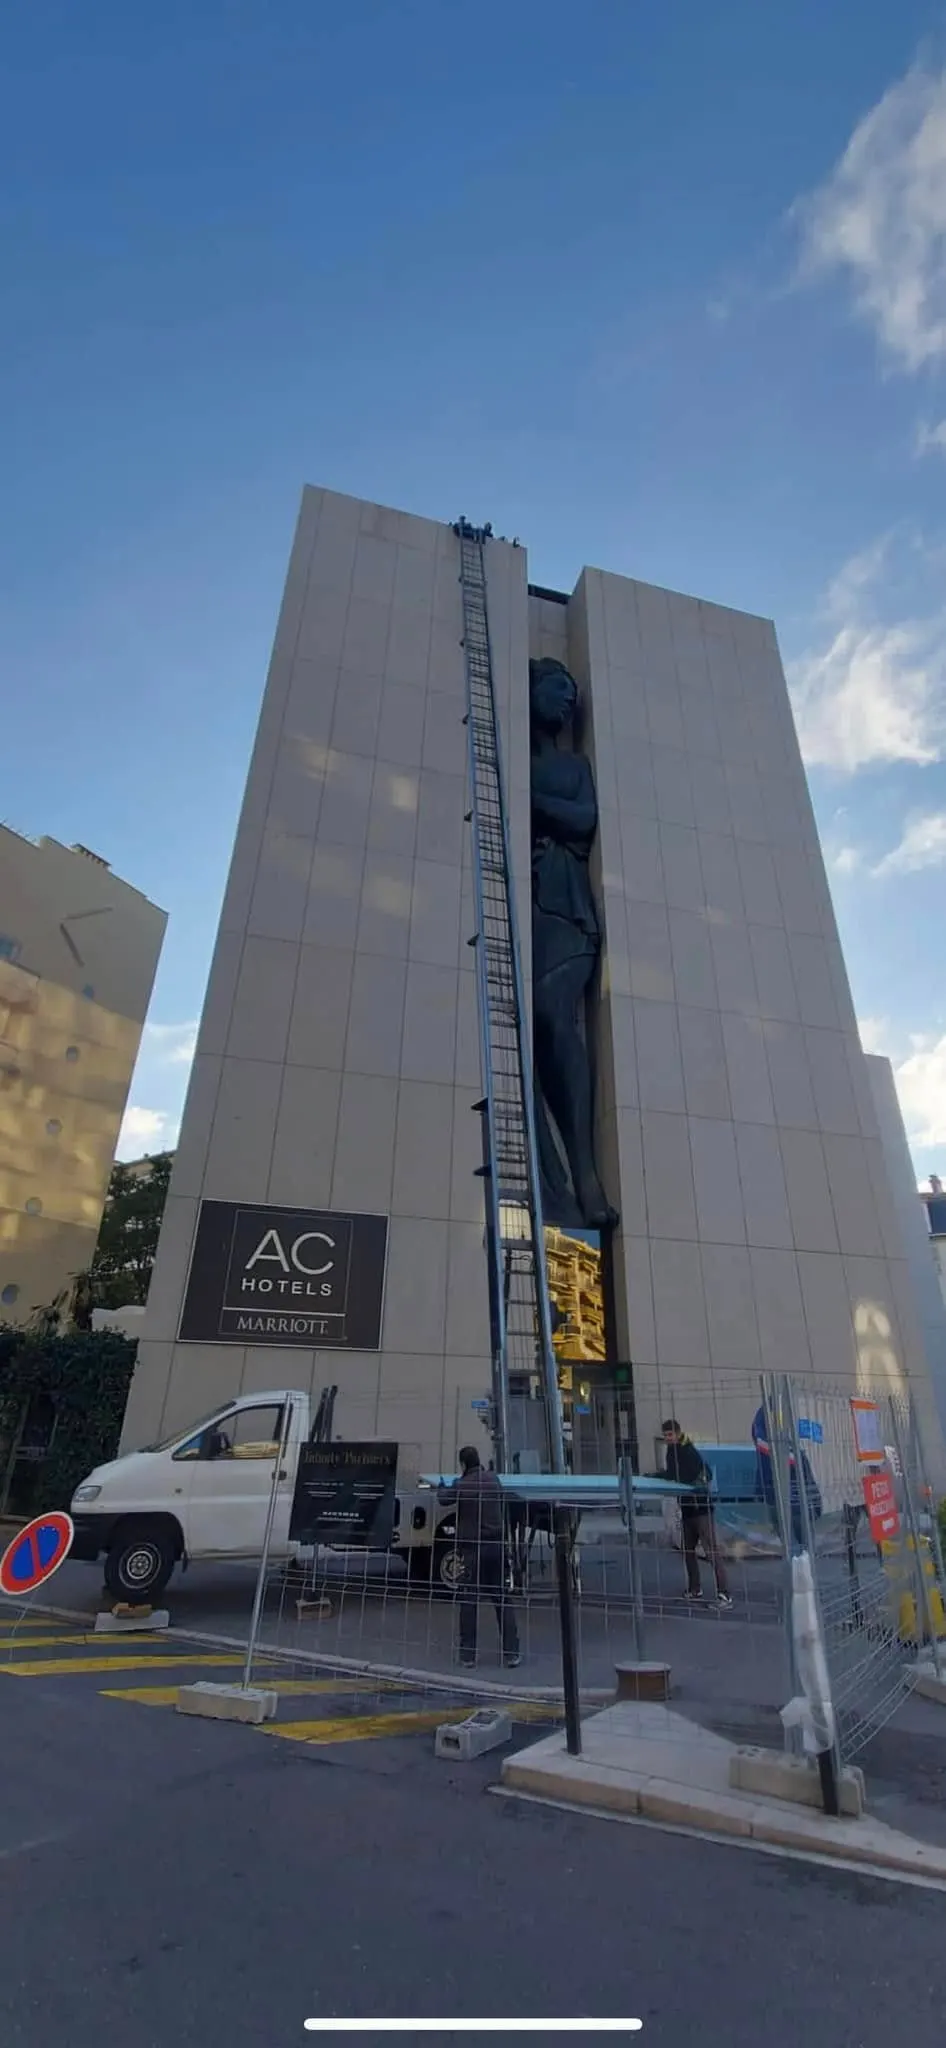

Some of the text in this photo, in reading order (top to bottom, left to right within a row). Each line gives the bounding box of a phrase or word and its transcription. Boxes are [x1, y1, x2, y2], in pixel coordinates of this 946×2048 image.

[245, 1229, 335, 1275] AC
[241, 1278, 332, 1296] HOTELS
[237, 1316, 328, 1334] MARRIOTT
